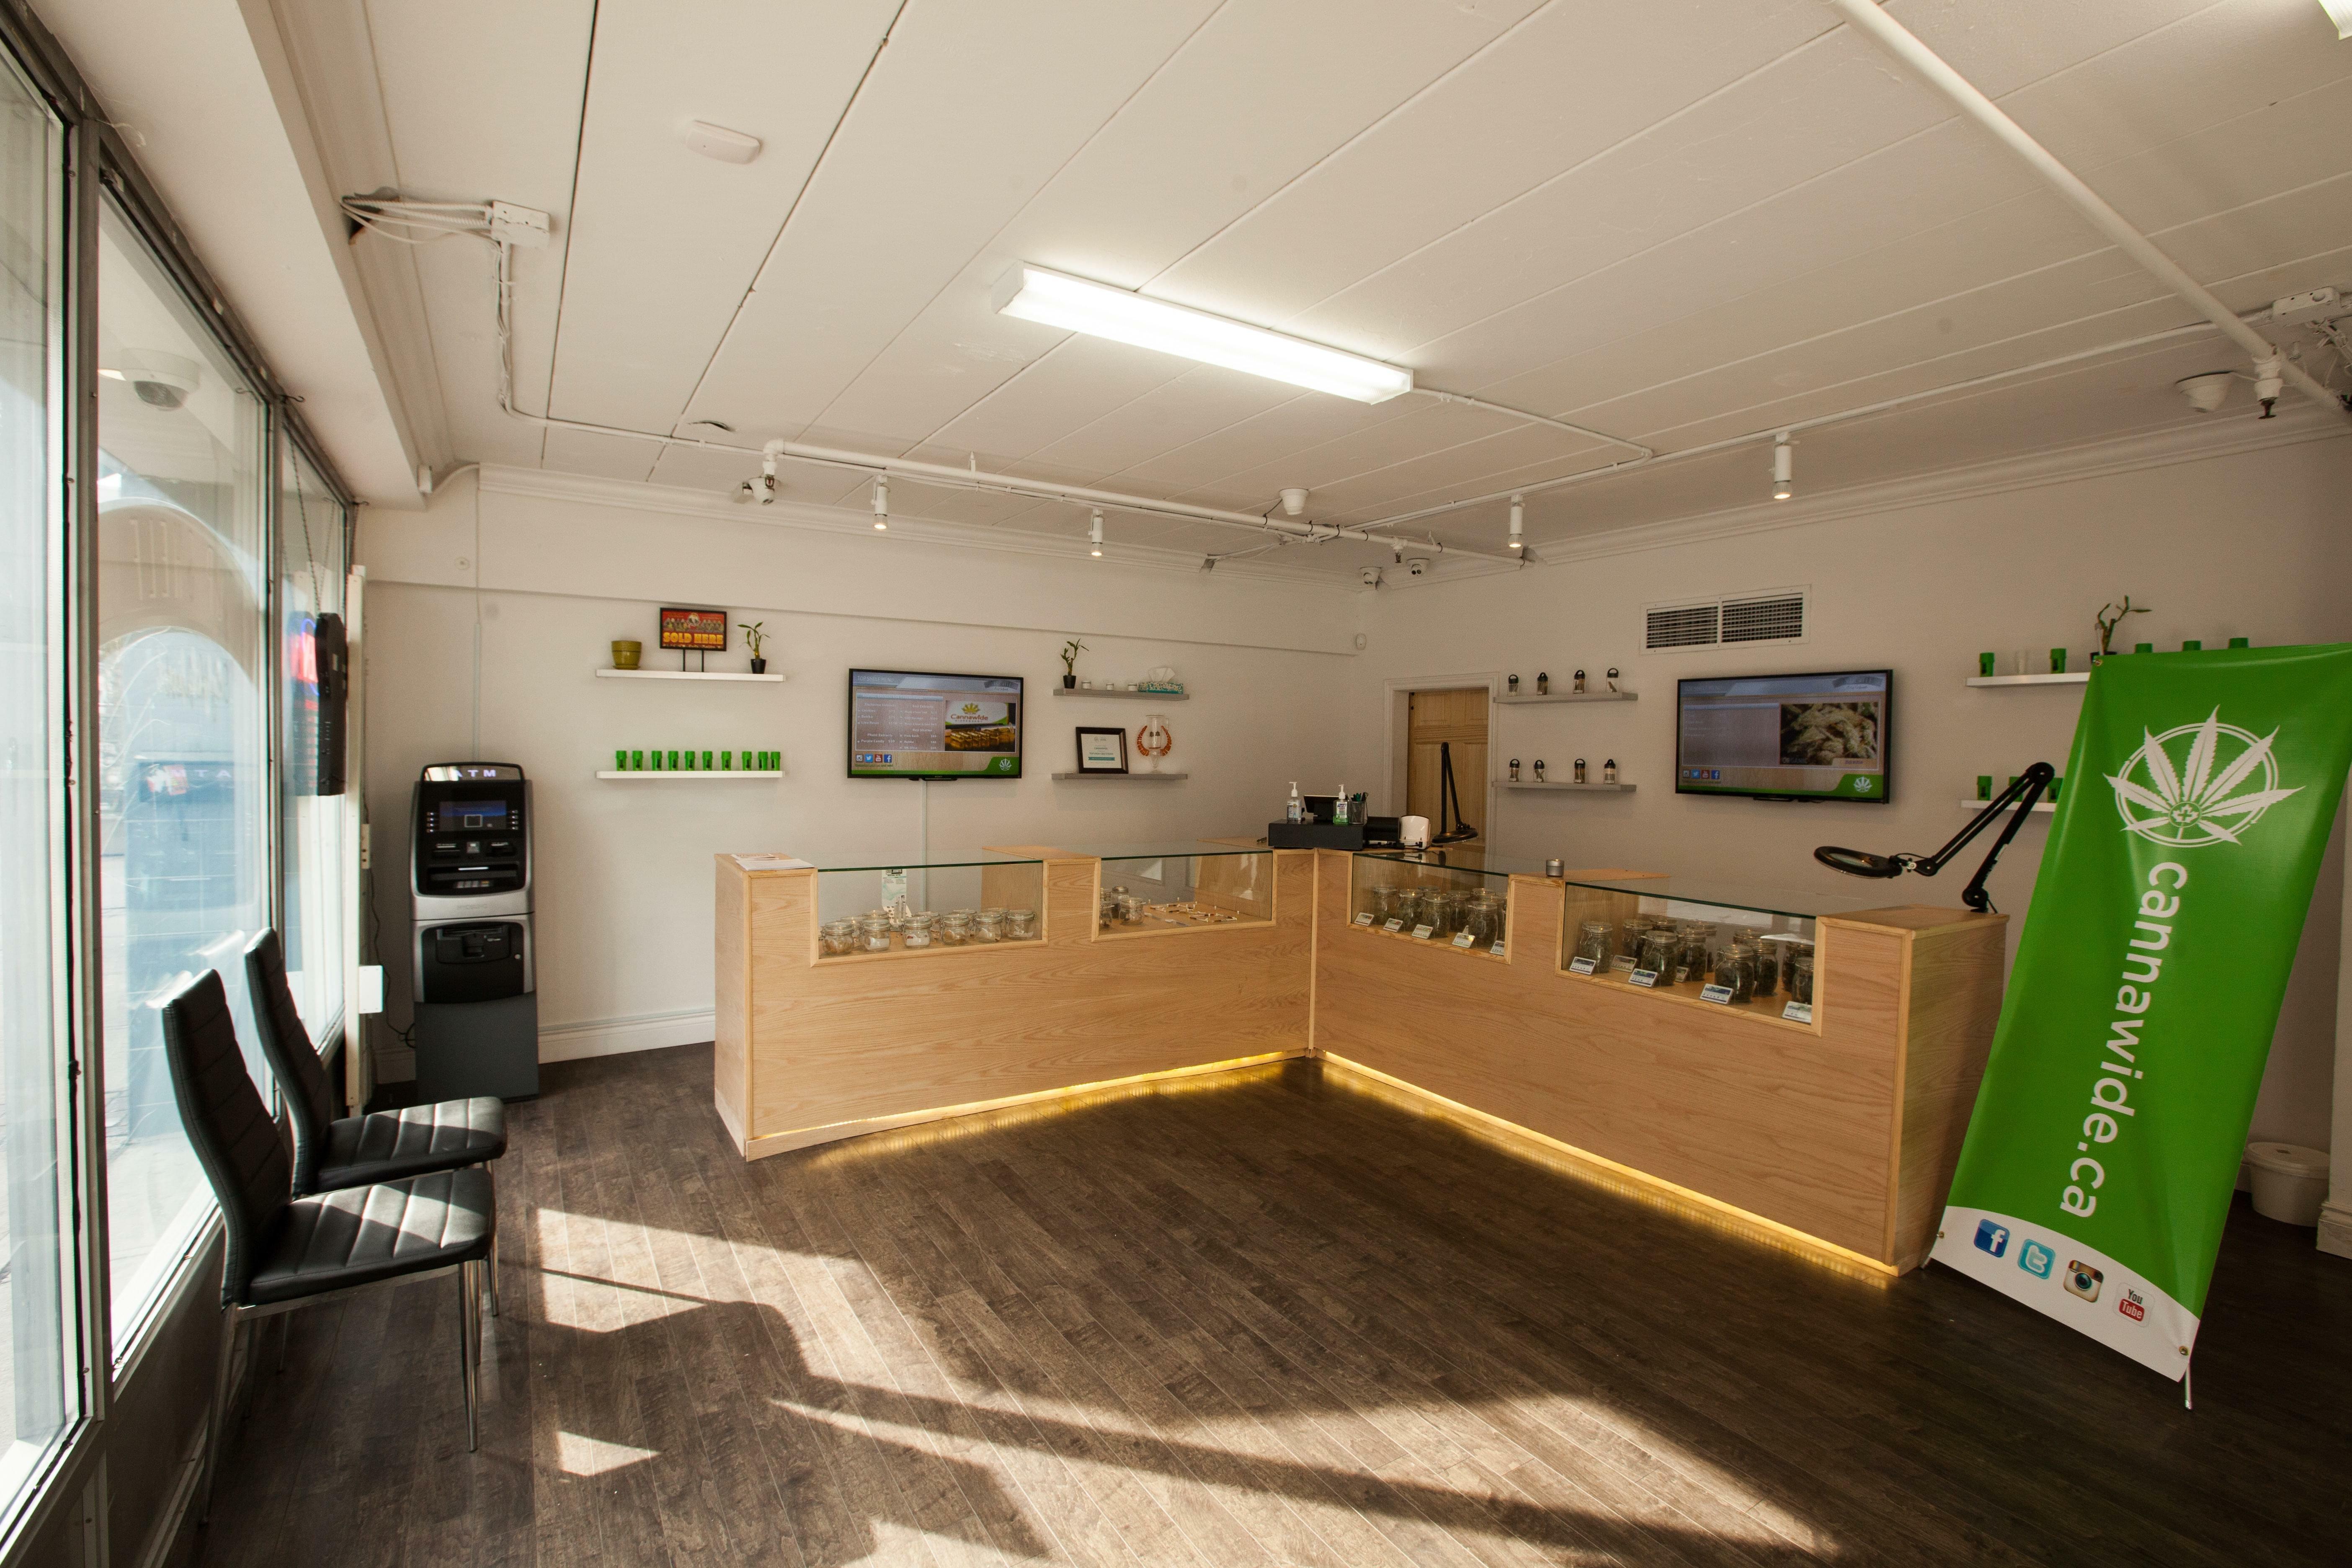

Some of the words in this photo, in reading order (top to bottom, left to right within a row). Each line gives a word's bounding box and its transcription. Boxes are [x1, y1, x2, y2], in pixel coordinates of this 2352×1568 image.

[663, 632, 691, 643] SOLD
[694, 633, 724, 644] HERE
[2059, 862, 2187, 1218] cannawide.ca
[2127, 1288, 2143, 1305] You
[2122, 1301, 2143, 1320] Tube
